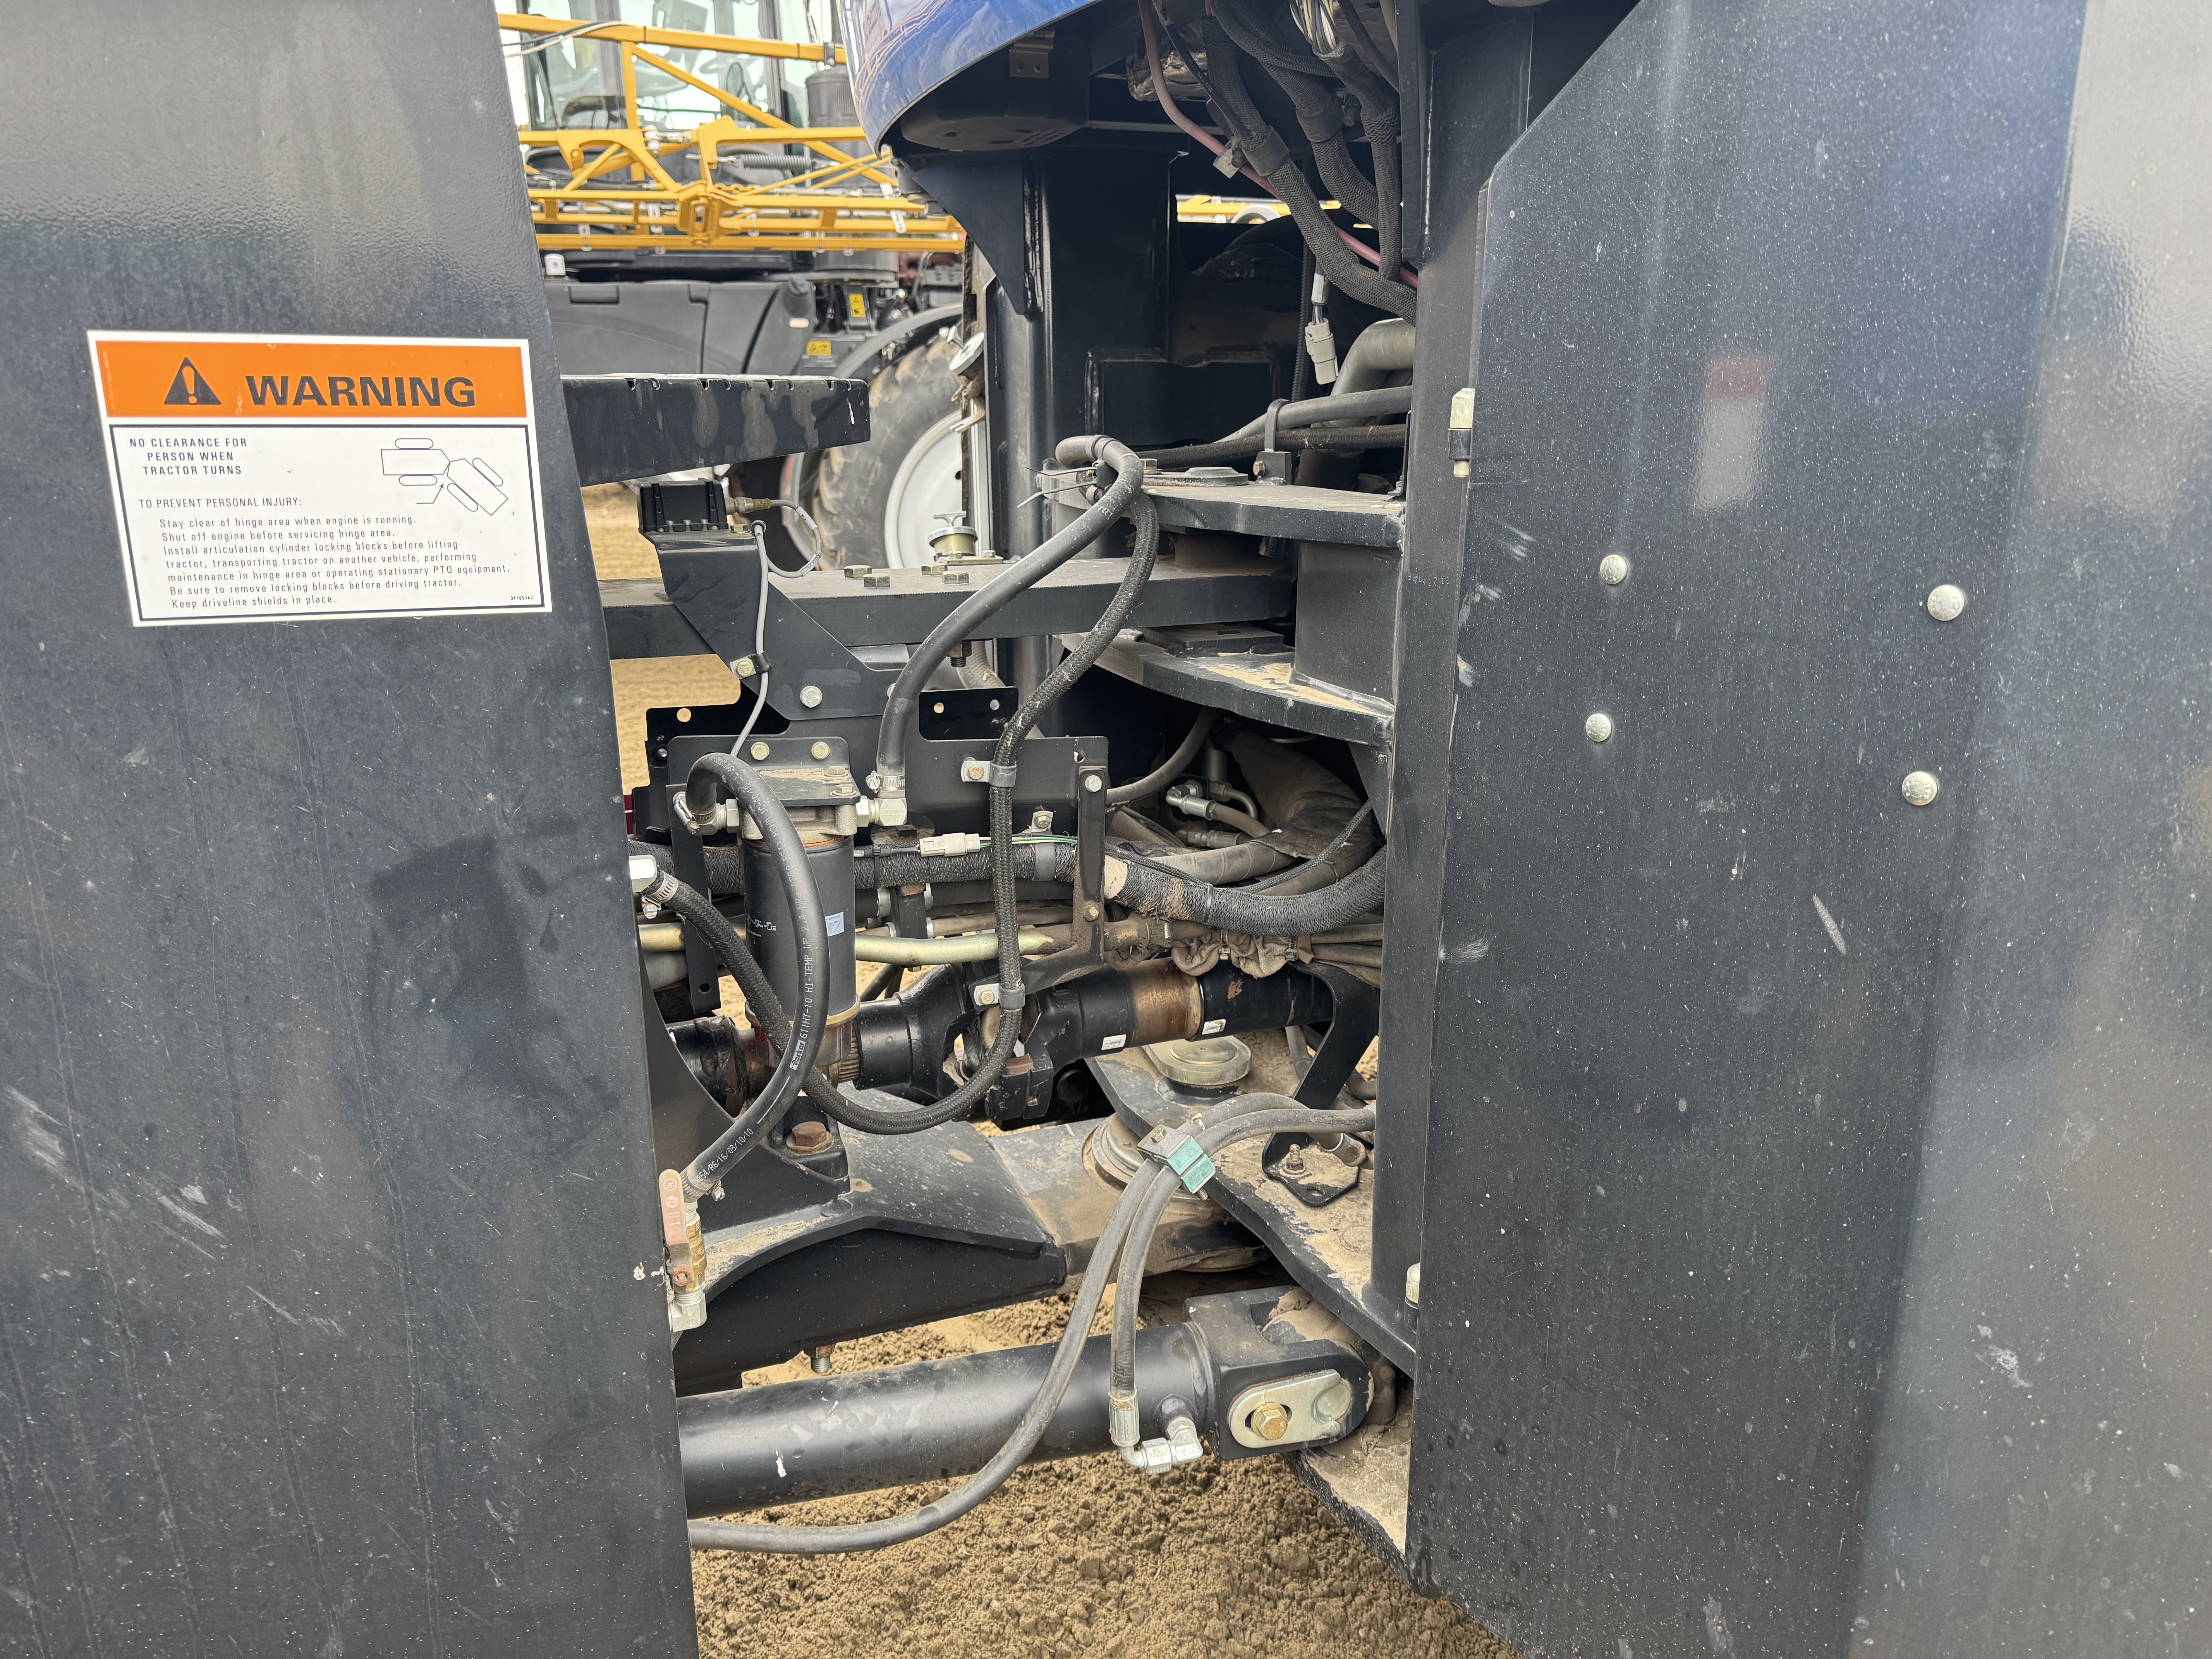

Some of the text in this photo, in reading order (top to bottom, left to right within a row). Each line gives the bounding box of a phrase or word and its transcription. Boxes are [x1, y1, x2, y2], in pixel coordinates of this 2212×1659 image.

[245, 375, 476, 407] WARNING
[129, 438, 247, 447] NO CLEARANCE FOR
[147, 452, 233, 462] PERSON WHEN
[142, 465, 241, 475] TRACTOR TURNS
[138, 497, 302, 508] TO PREVENT PERSONAL INJURY:
[160, 519, 183, 530] Stay
[189, 517, 214, 527] clear
[220, 517, 230, 527] of
[235, 517, 263, 528] hinge
[295, 516, 321, 525] when
[326, 515, 358, 527] engine
[363, 515, 371, 524] is
[376, 515, 416, 525] running.
[162, 532, 186, 541] Shut
[191, 532, 206, 541] off
[211, 531, 245, 542] engine
[250, 530, 283, 540] before
[288, 529, 334, 540] servicing
[339, 529, 365, 539] hinge
[163, 540, 457, 555] Install articulation cylinder locking blocks before lifting
[166, 560, 207, 569] tractor,
[213, 557, 277, 568] transporting
[282, 557, 318, 565] tractor
[339, 555, 376, 564] another
[381, 553, 419, 563] vehicle,
[424, 552, 476, 563] performing
[168, 573, 234, 582] maintenance
[239, 571, 248, 580] in
[253, 570, 280, 581] hinge
[326, 568, 373, 579] operating
[378, 567, 428, 577] stationary
[433, 565, 452, 574] PTO
[457, 565, 509, 575] equipment.
[170, 586, 182, 595] Be
[215, 586, 225, 594] to
[271, 582, 307, 593] locking
[313, 581, 344, 591] blocks
[349, 580, 380, 589] before
[385, 579, 419, 589] driving
[172, 595, 335, 610] Keep driveline shields in place.
[804, 954, 813, 993] HI-TEMP
[800, 998, 812, 1039] 611HT-10
